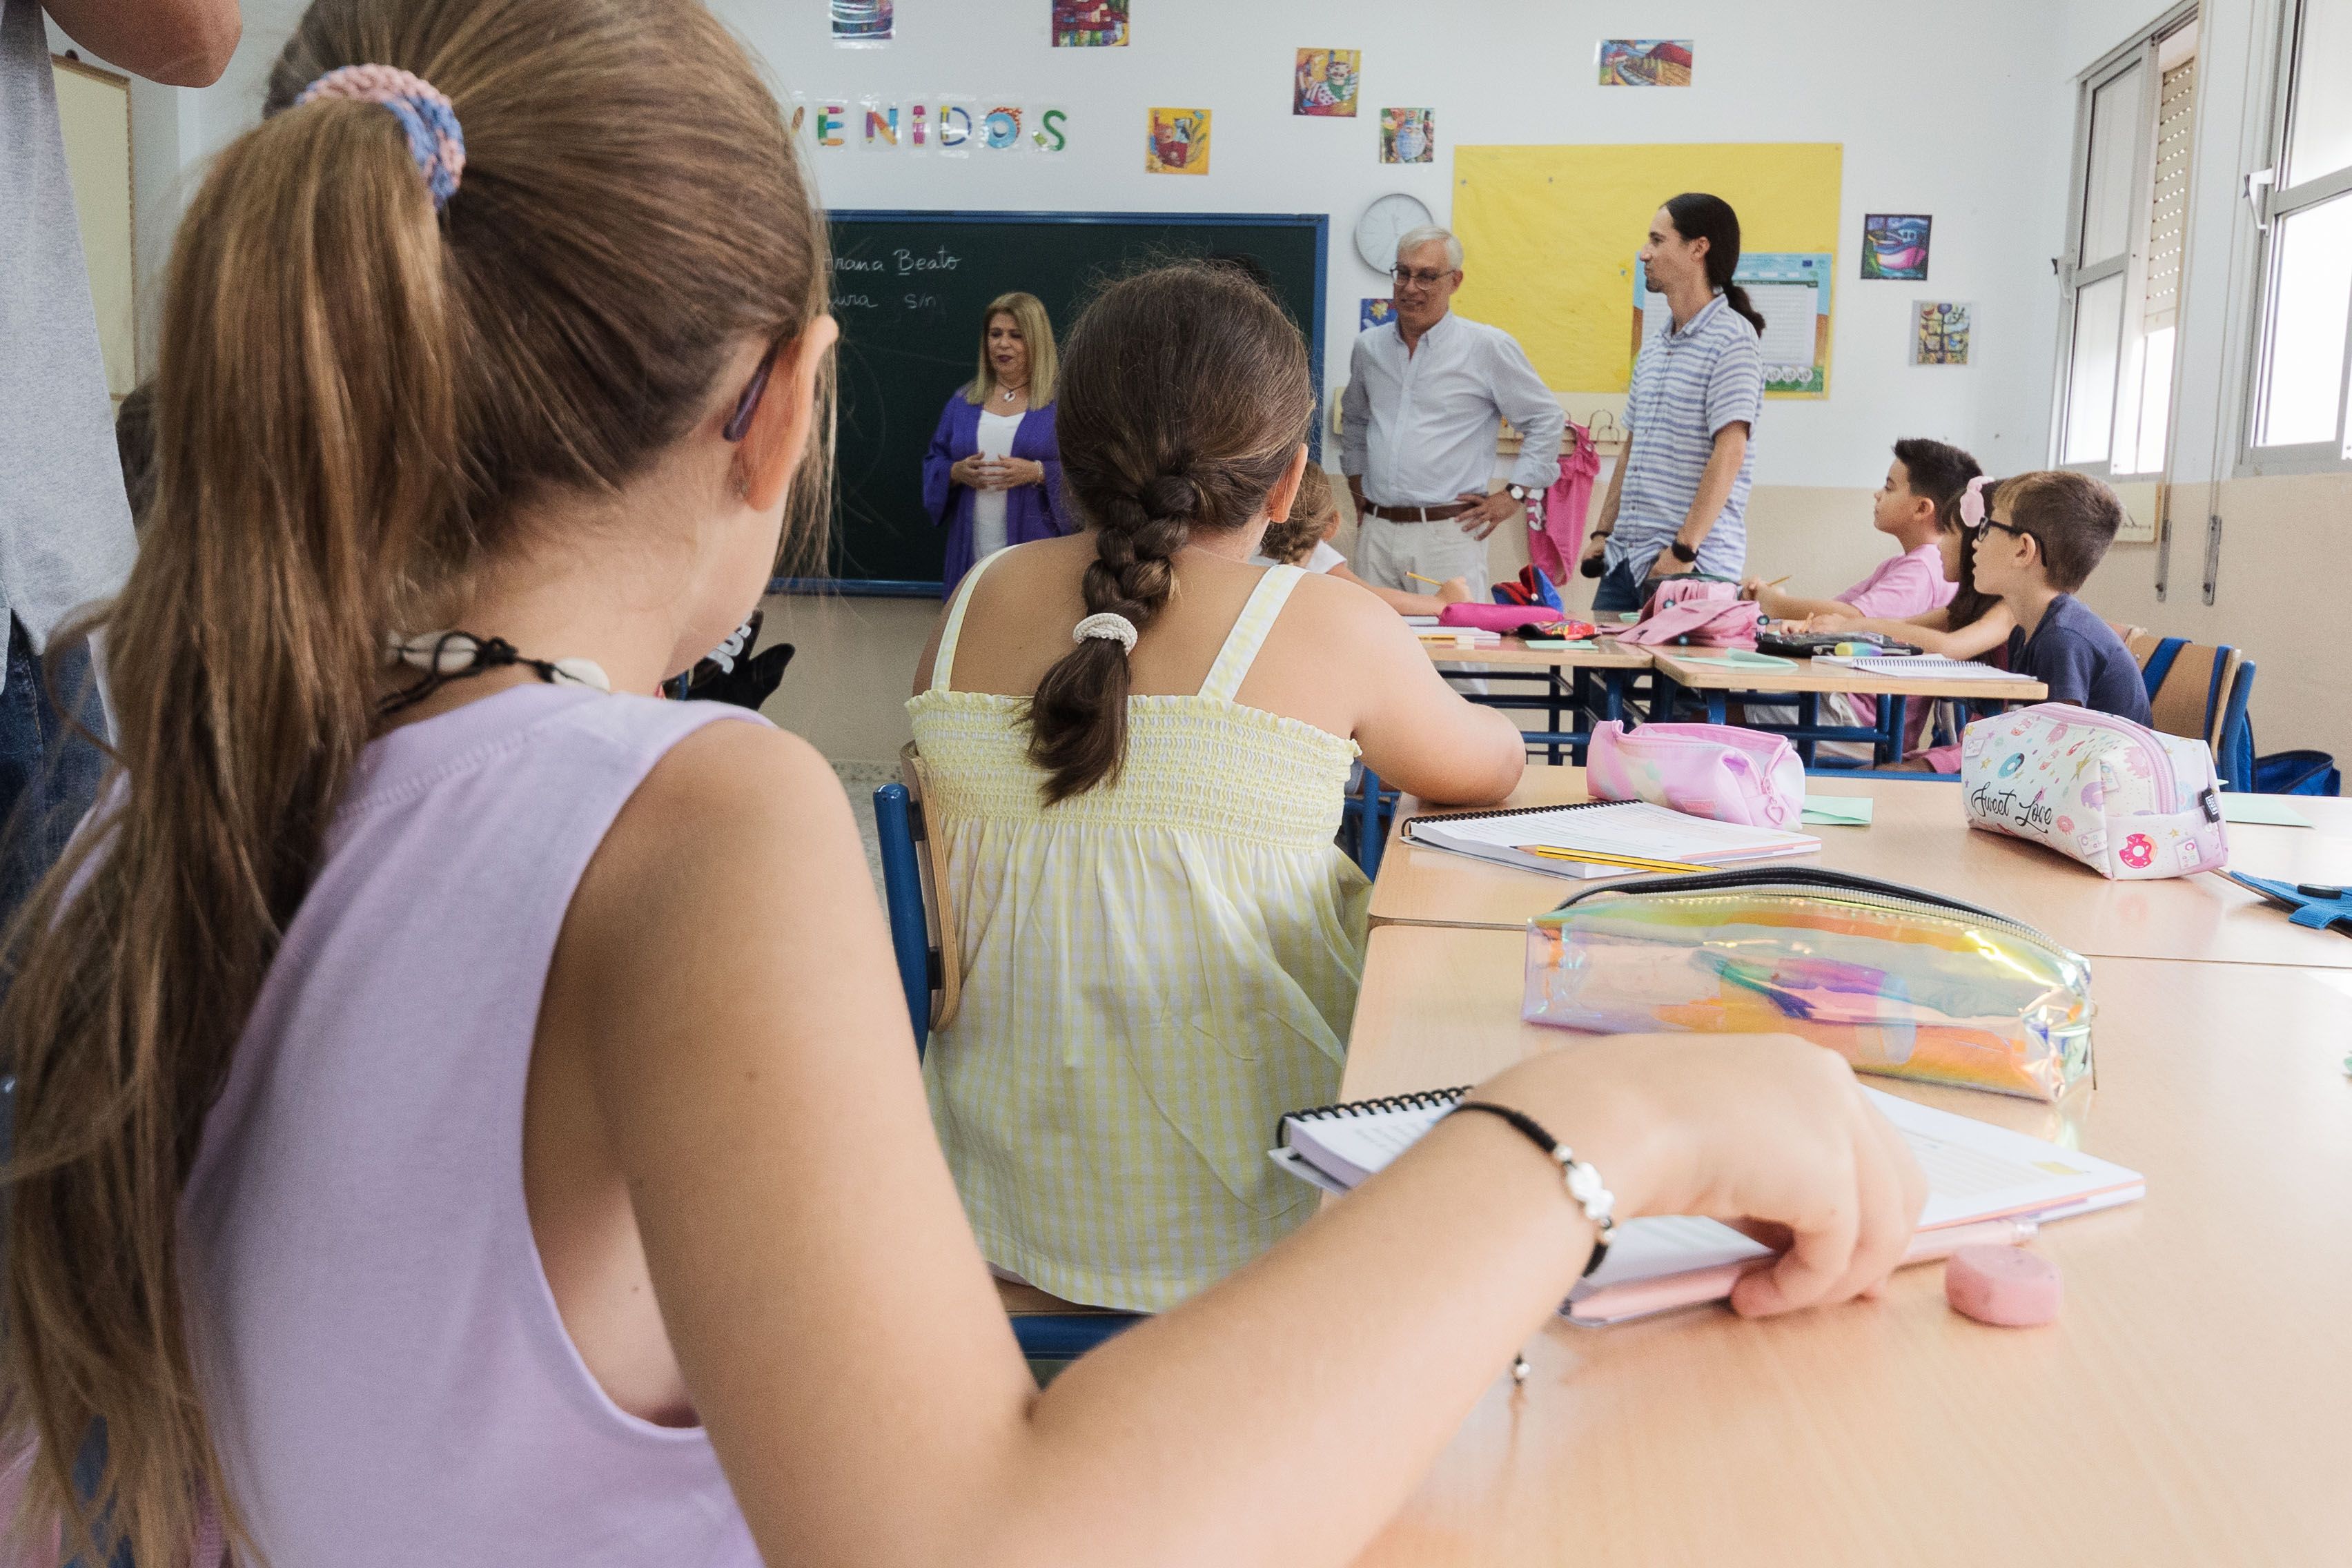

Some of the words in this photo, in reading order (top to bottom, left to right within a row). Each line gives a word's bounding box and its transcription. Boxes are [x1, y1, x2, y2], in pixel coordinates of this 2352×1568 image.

[892, 245, 962, 273] Beato
[1971, 781, 2017, 817] Sweet
[2015, 790, 2053, 834] Love
